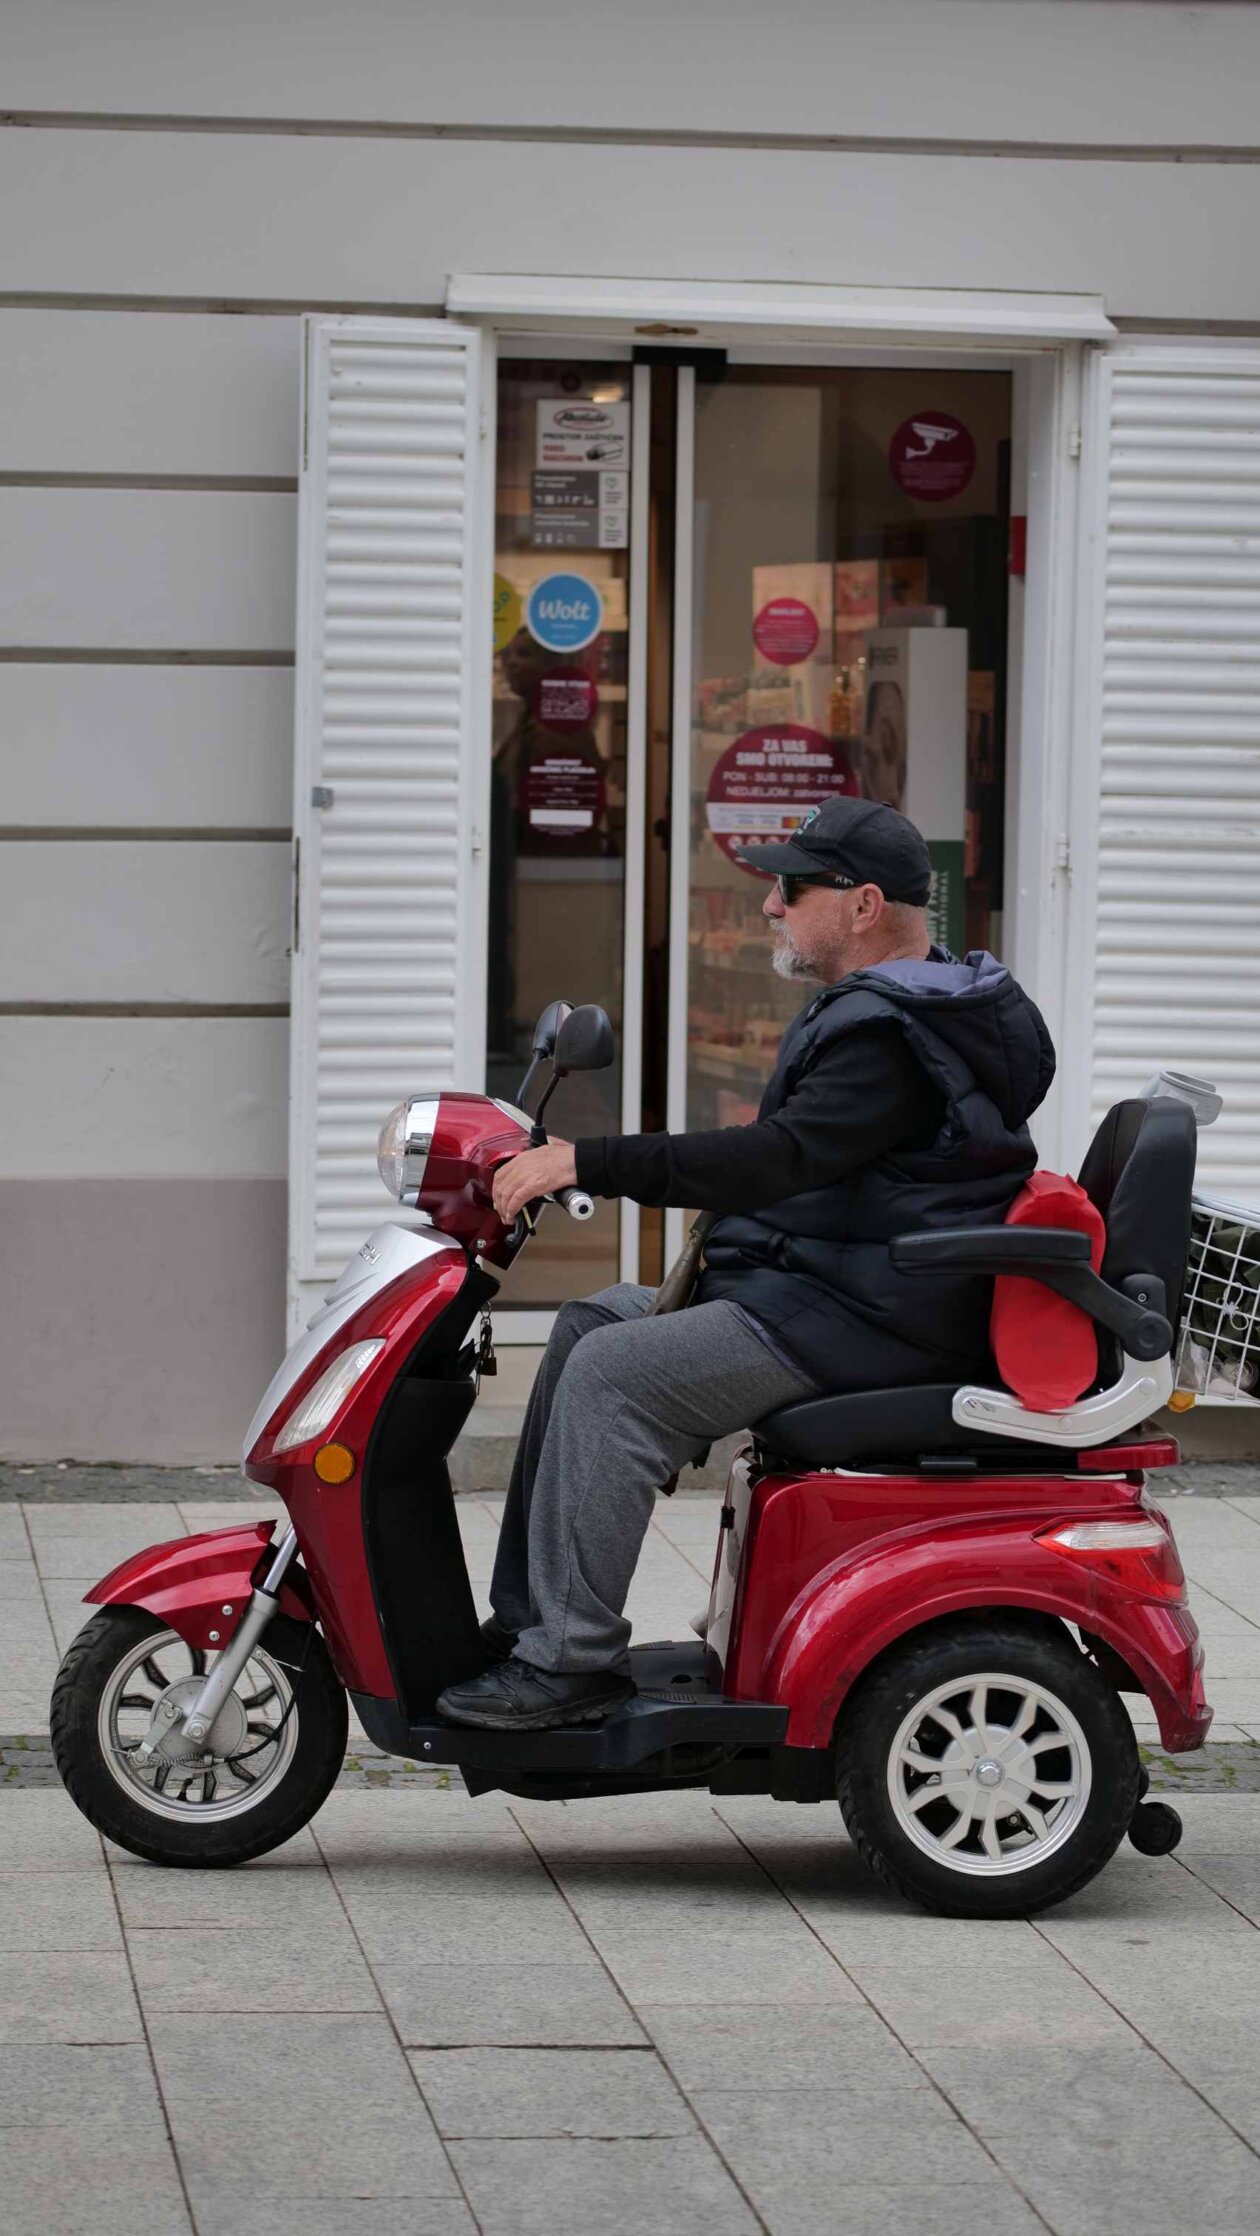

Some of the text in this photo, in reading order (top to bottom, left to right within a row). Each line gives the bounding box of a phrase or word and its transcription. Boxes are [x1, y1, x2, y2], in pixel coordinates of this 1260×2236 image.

[538, 599, 592, 621] Wolt
[762, 739, 807, 753] ZA VAS
[736, 752, 766, 766] SMO
[723, 772, 746, 781] PON
